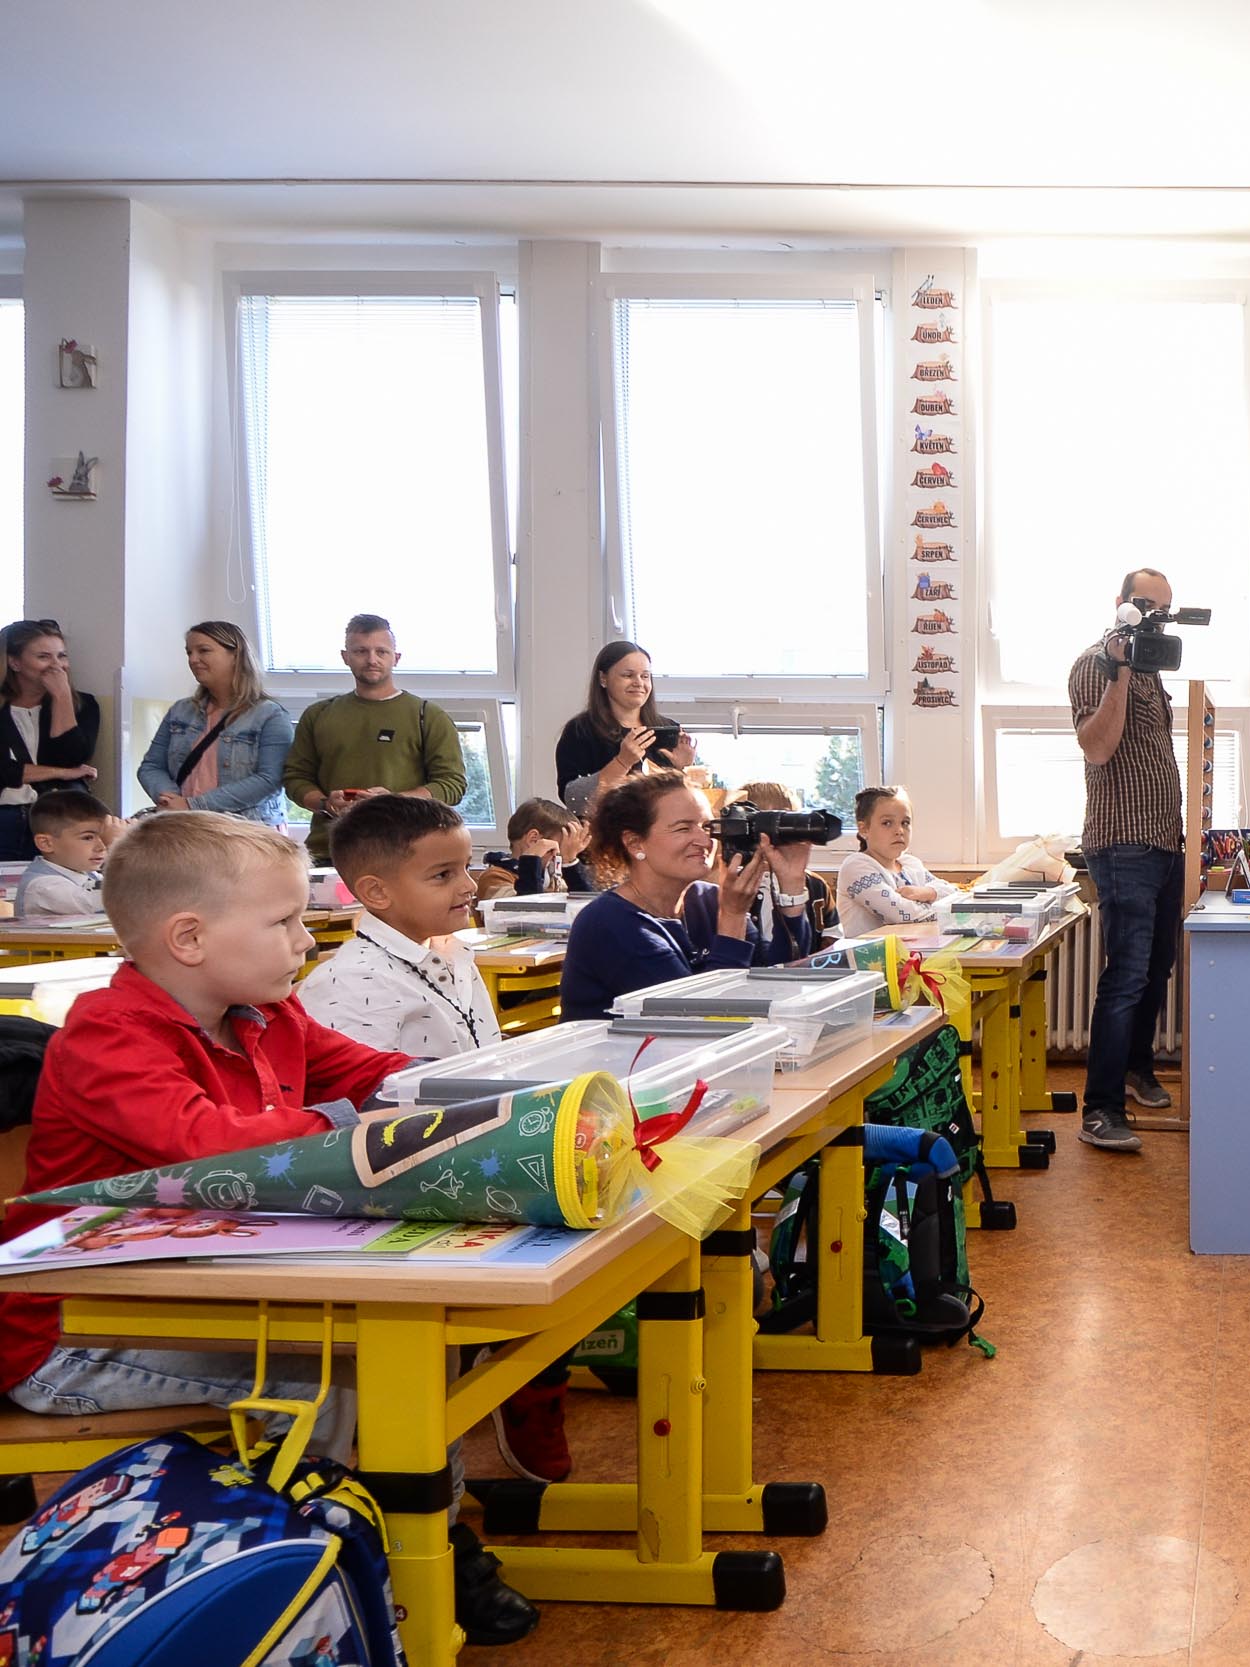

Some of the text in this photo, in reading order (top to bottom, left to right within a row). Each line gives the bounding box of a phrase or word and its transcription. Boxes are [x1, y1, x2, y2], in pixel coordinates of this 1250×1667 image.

[922, 296, 943, 305] LEDEN
[922, 330, 942, 340] ÚNOR
[920, 367, 944, 377] BŘEZEN
[921, 402, 943, 412] DUBEN
[920, 440, 944, 450] KVĚTEN
[919, 474, 945, 485] ČERVEN
[917, 513, 948, 523] ČERVENEC
[921, 550, 943, 558] SRPEN
[918, 660, 948, 669] LISTOPAD
[581, 1334, 618, 1351] lzeň
